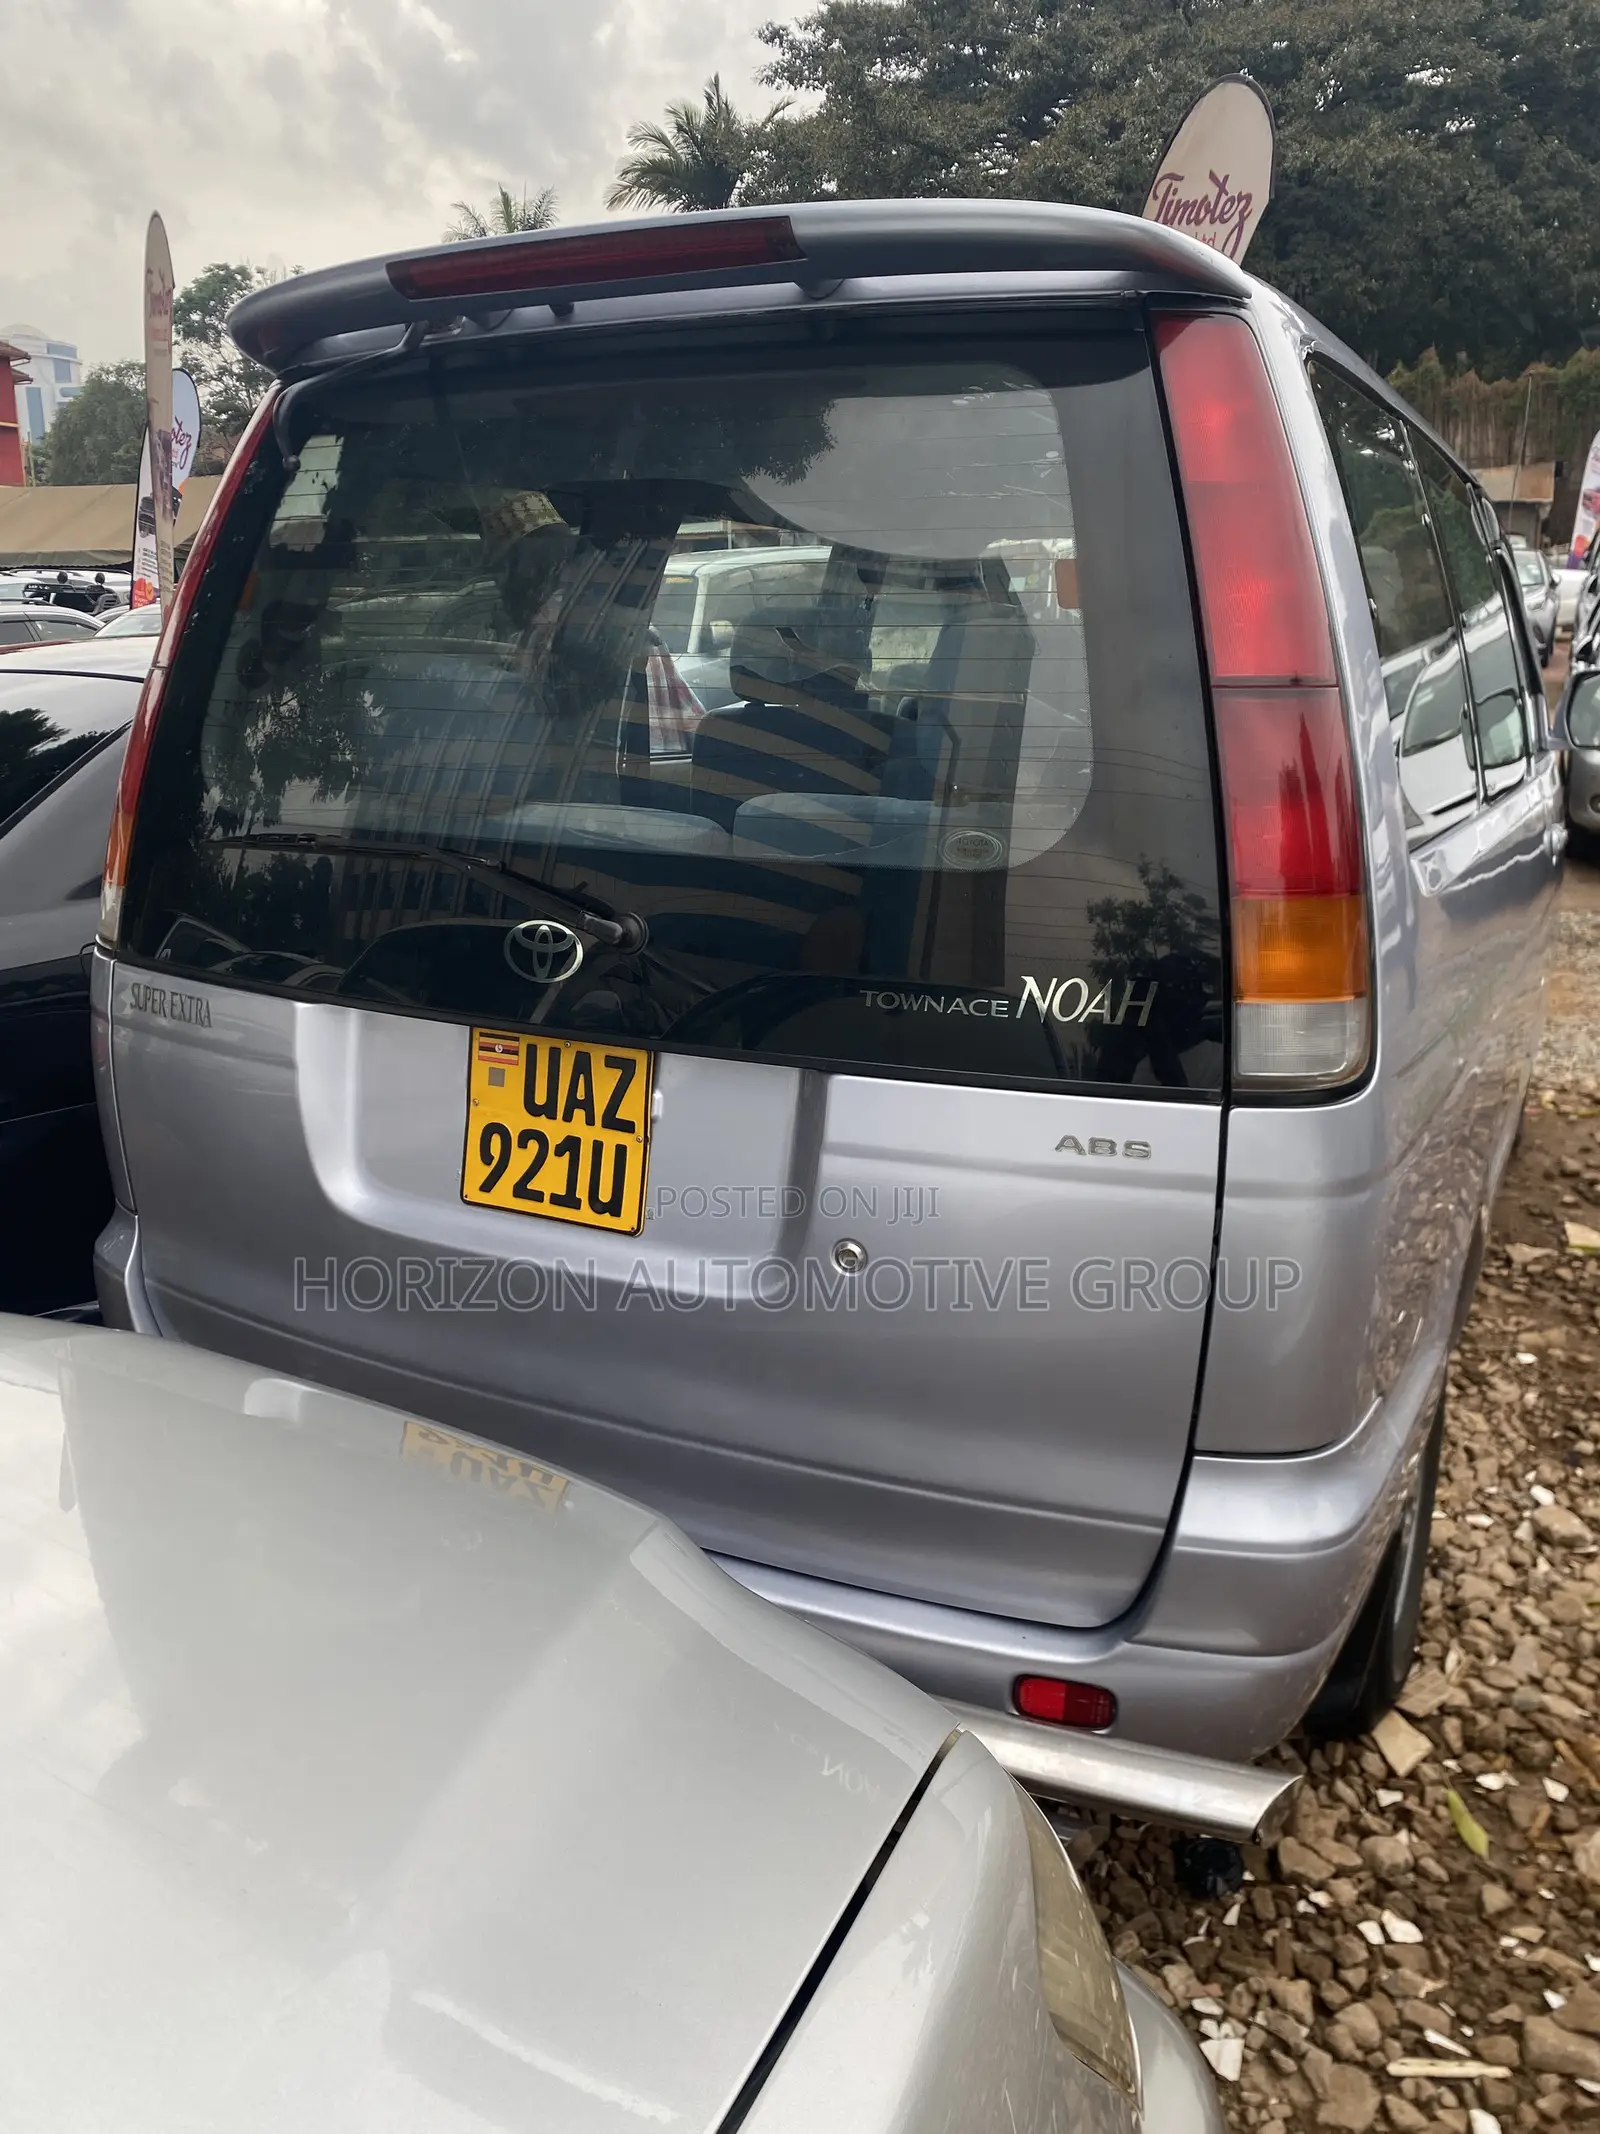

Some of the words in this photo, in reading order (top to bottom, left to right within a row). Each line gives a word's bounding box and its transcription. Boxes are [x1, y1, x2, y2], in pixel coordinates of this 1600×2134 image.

[1153, 169, 1253, 259] Timotez
[171, 415, 192, 469] otez
[130, 982, 167, 1018] SUPER
[170, 991, 212, 1028] EXTRA
[860, 989, 1009, 1018] TOWNACE
[1016, 976, 1158, 1027] NOAH
[523, 1043, 637, 1134] UAZ
[479, 1122, 628, 1218] 921U
[1055, 1134, 1151, 1160] ABS
